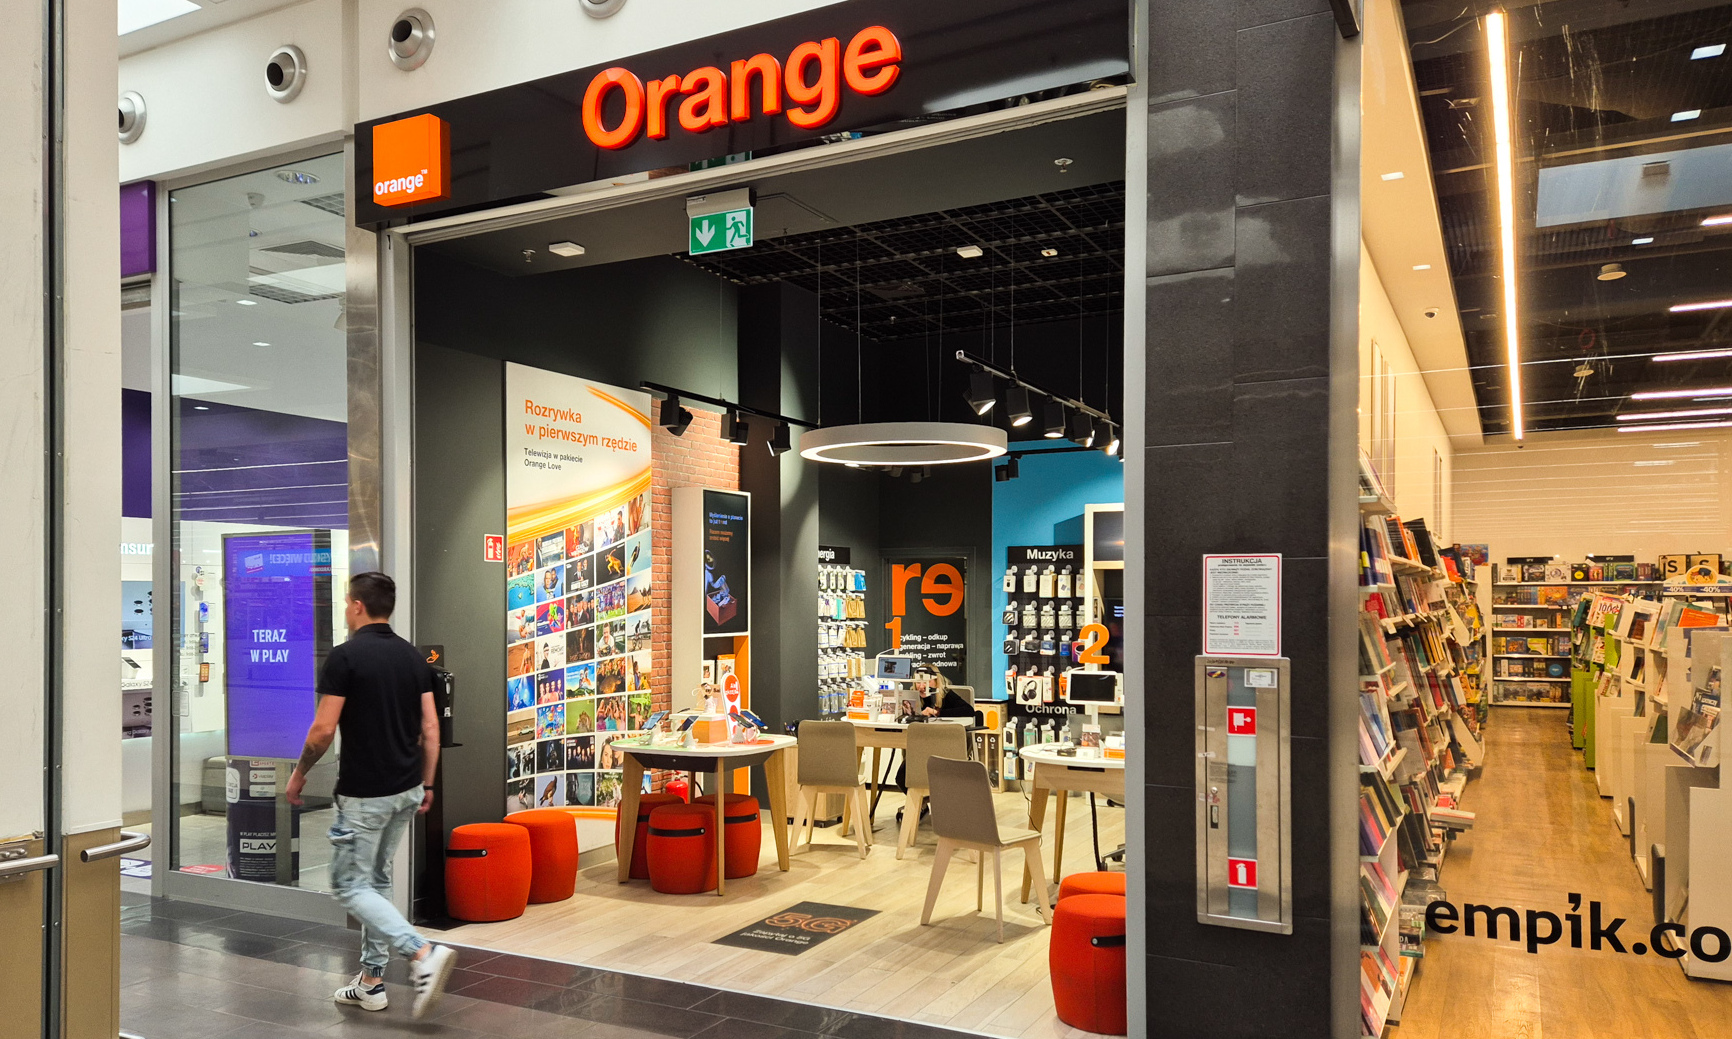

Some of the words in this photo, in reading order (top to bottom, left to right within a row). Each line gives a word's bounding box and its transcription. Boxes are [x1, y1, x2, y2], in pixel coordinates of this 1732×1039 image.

[582, 25, 902, 150] Orange
[525, 399, 582, 423] Rozrywka
[525, 423, 535, 435] w
[539, 424, 598, 447] pierwszym
[601, 437, 637, 452] rzędzie
[524, 447, 552, 459] Telewizja
[559, 454, 583, 463] pakiecie
[524, 458, 546, 469] Orange
[547, 461, 562, 470] Love
[1027, 549, 1074, 562] Muzyka
[252, 629, 287, 642] TERAZ
[885, 617, 901, 649] 1
[1078, 623, 1110, 664] 2
[250, 650, 260, 662] W
[262, 650, 289, 662] PLAY
[1025, 704, 1077, 715] Ochrona
[242, 842, 276, 850] PLAY
[766, 912, 850, 934] 5G
